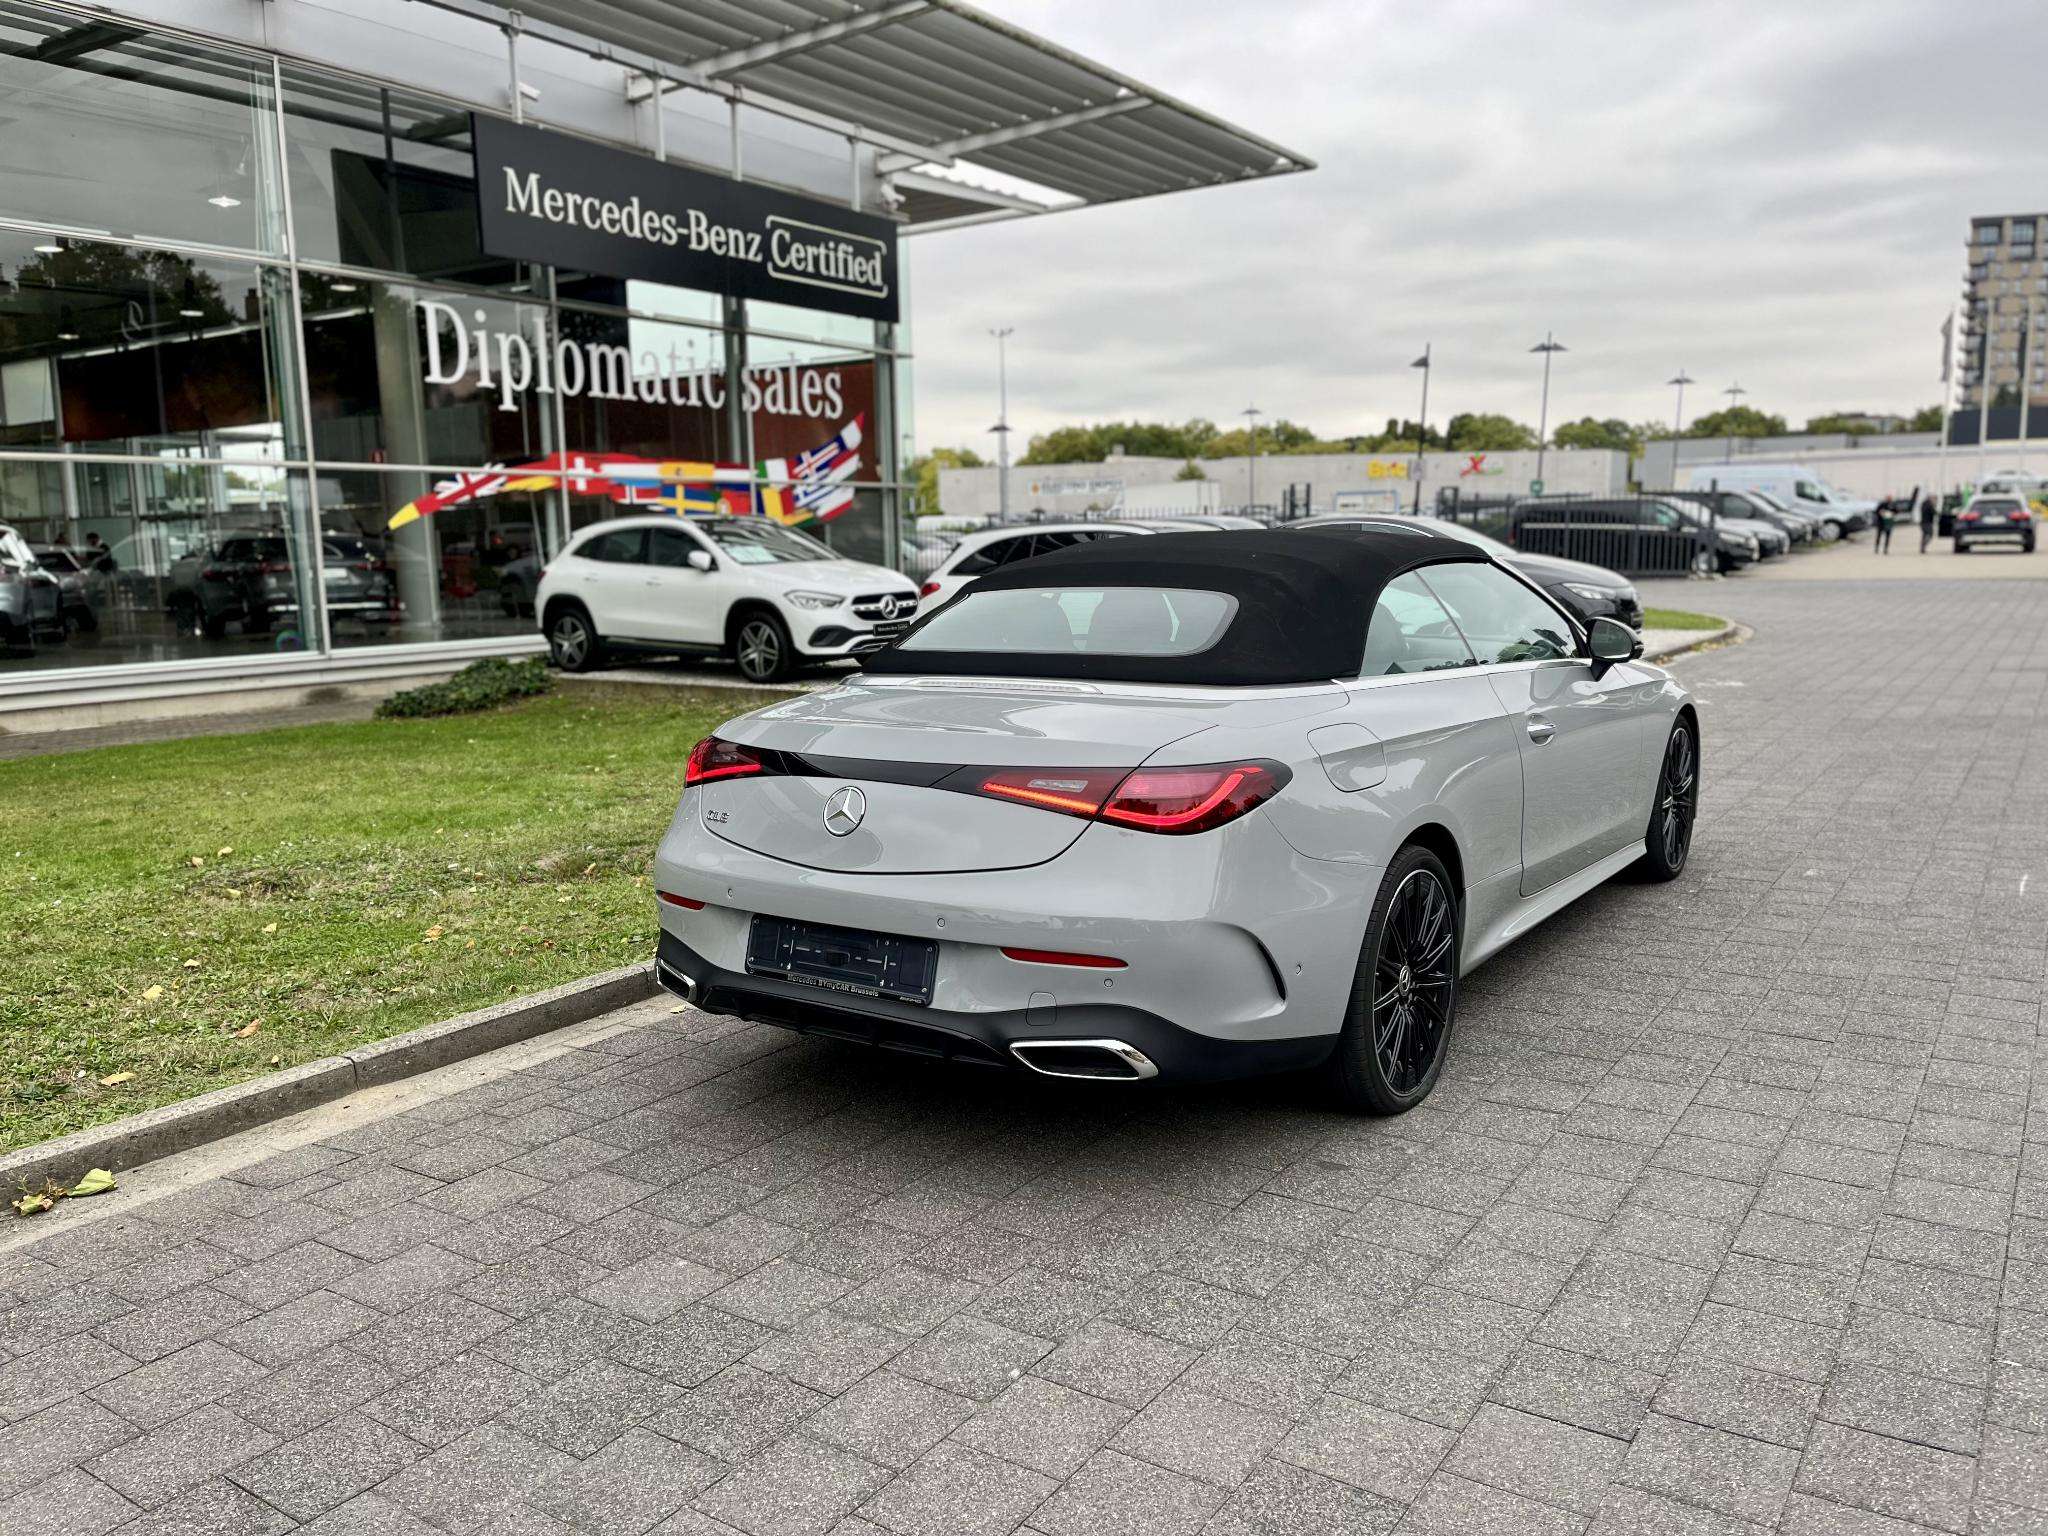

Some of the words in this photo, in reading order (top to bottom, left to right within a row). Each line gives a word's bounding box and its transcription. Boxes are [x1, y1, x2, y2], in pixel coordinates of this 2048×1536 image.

[503, 166, 763, 263] Mercedes-Benz
[770, 229, 884, 287] Certified
[420, 300, 726, 412] Diplomatic
[741, 353, 844, 420] sales
[787, 973, 816, 985] Mercedes
[851, 985, 879, 997] Brussels
